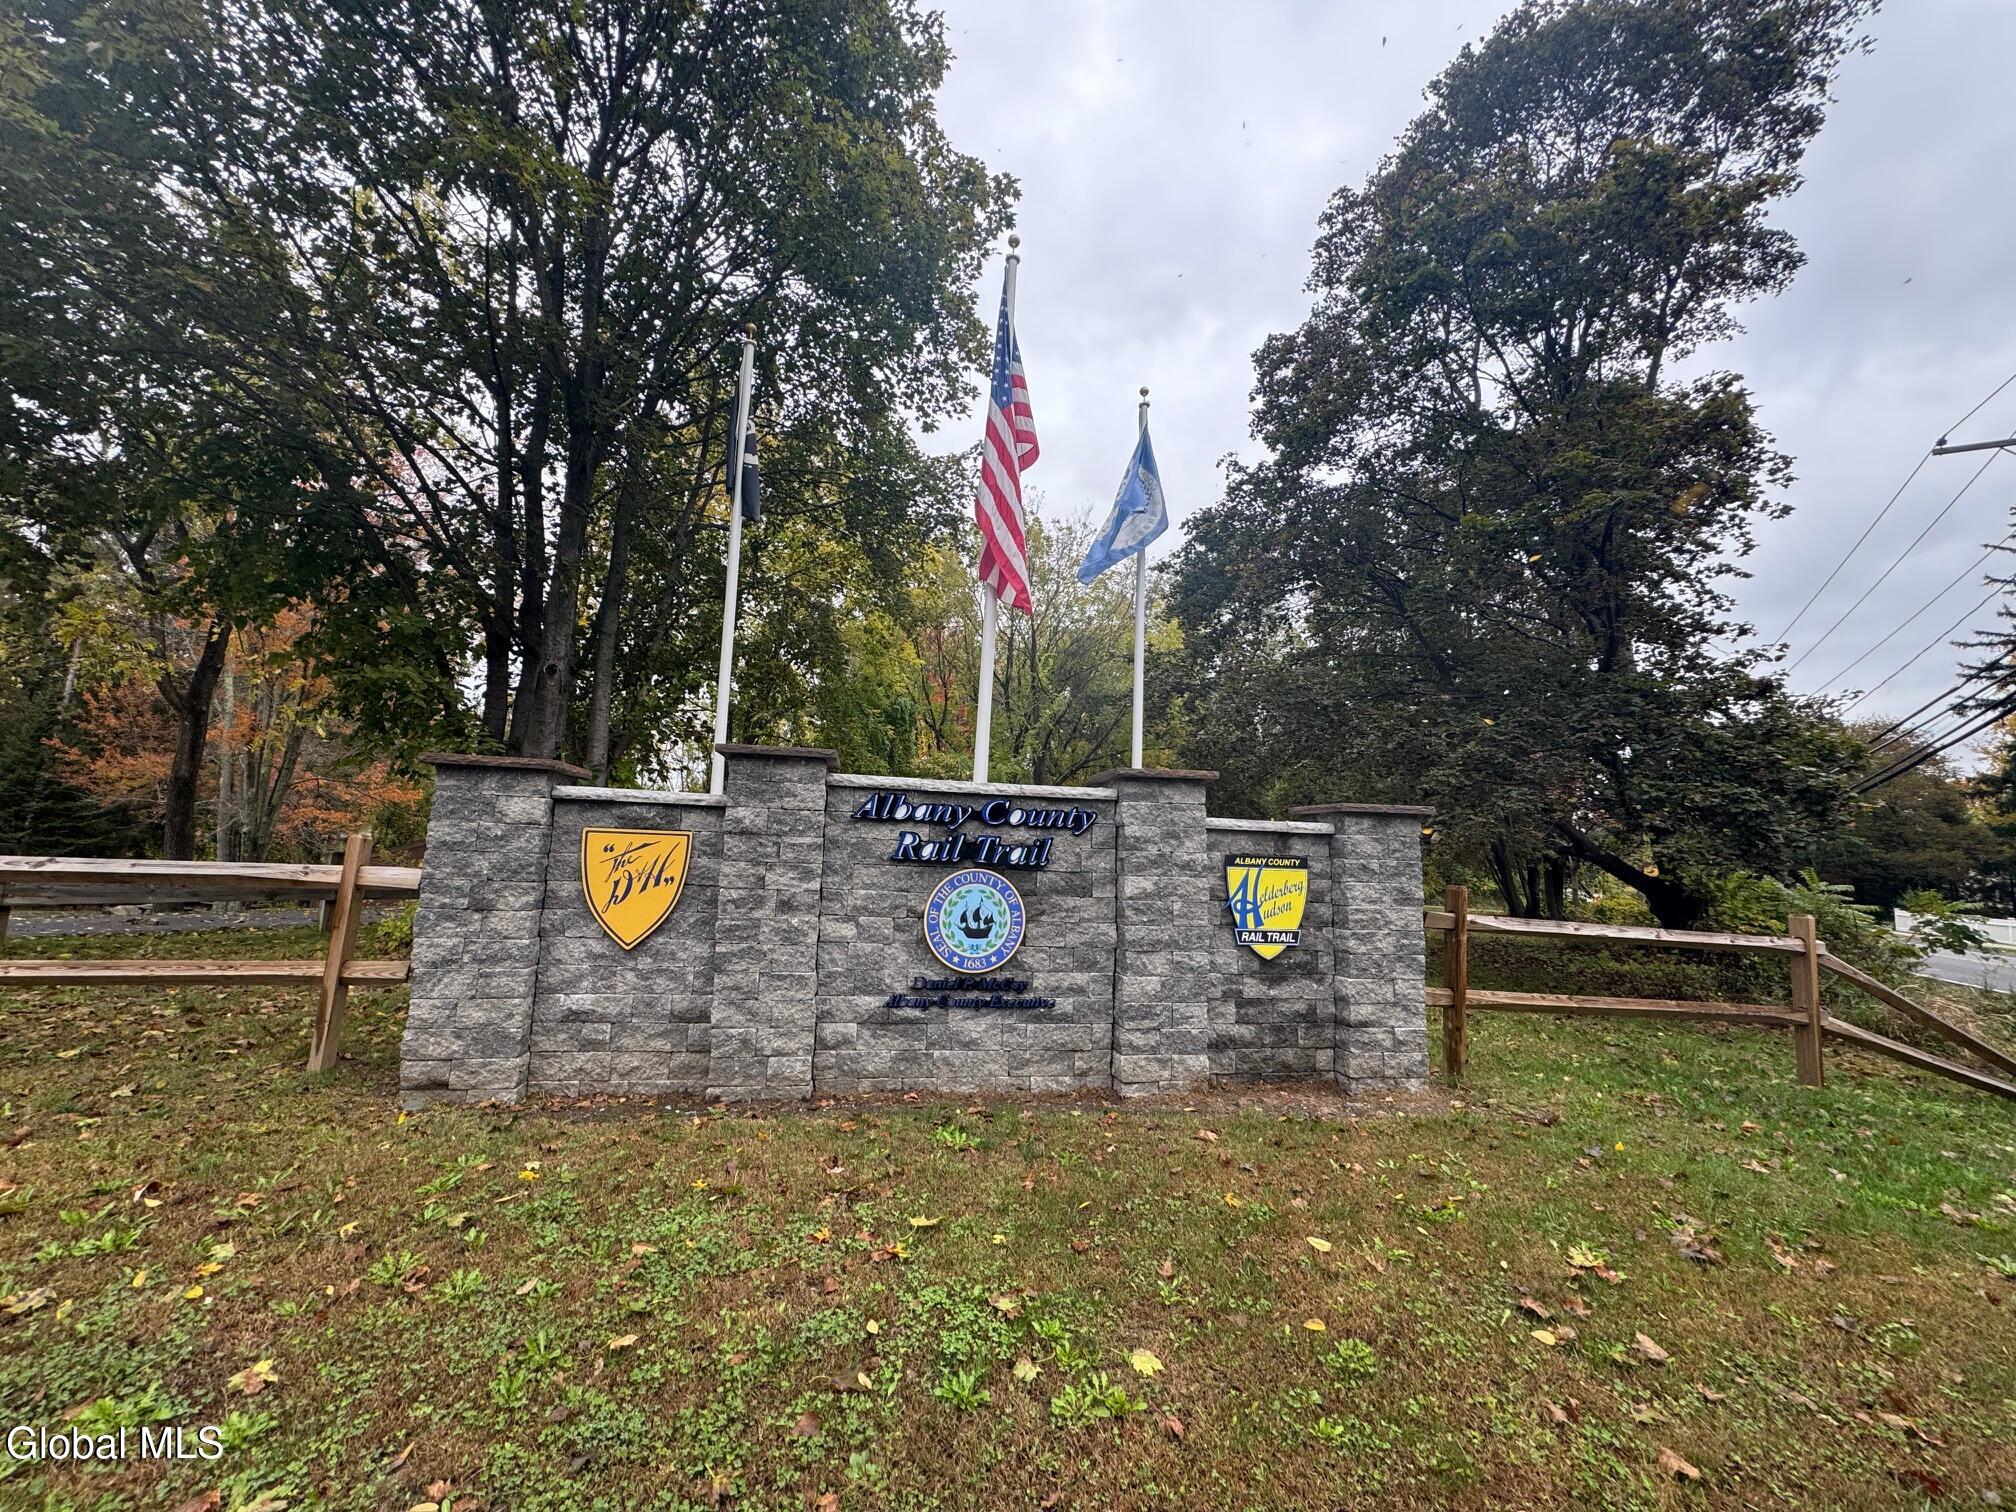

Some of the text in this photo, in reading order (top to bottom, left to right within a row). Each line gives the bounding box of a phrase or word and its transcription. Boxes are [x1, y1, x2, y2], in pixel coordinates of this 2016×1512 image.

[852, 793, 1097, 836] Albany County
[890, 831, 1054, 867] Rail Trail
[1234, 857, 1301, 867] ALBANY COUNTY
[928, 872, 1022, 958] SEAL OF THE COUNTY OF ALBANY
[1241, 932, 1296, 943] RAIL TRAIL
[963, 958, 987, 969] 1683
[911, 976, 961, 991] Daniel
[883, 994, 1056, 1011] Albany County Executive
